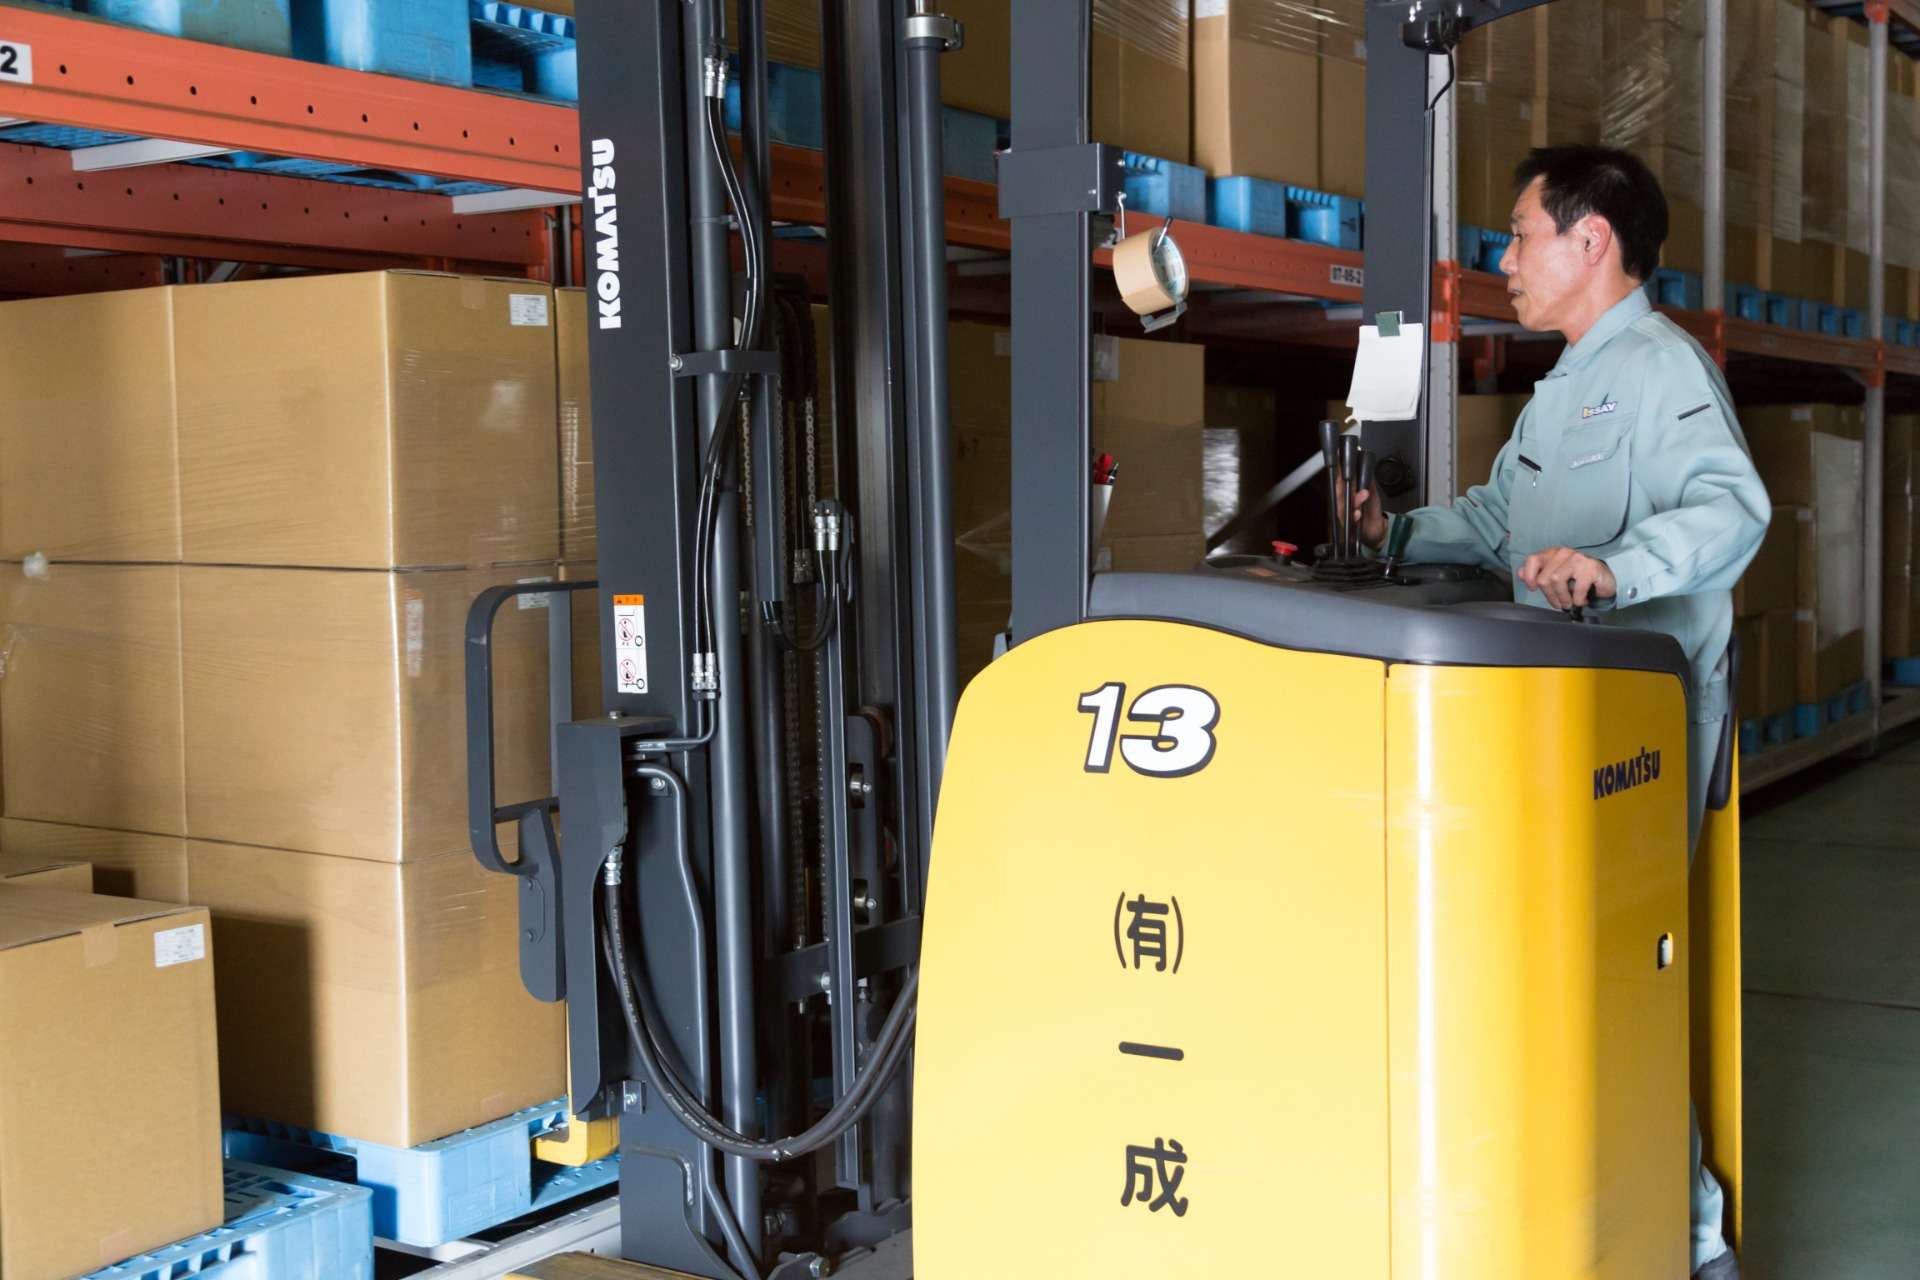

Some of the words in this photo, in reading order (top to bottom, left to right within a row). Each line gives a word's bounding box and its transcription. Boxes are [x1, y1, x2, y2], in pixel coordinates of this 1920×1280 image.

[0, 45, 18, 75] 2
[588, 138, 622, 330] KOMATSU
[1077, 682, 1221, 778] 13
[1593, 746, 1661, 800] KOMATSU
